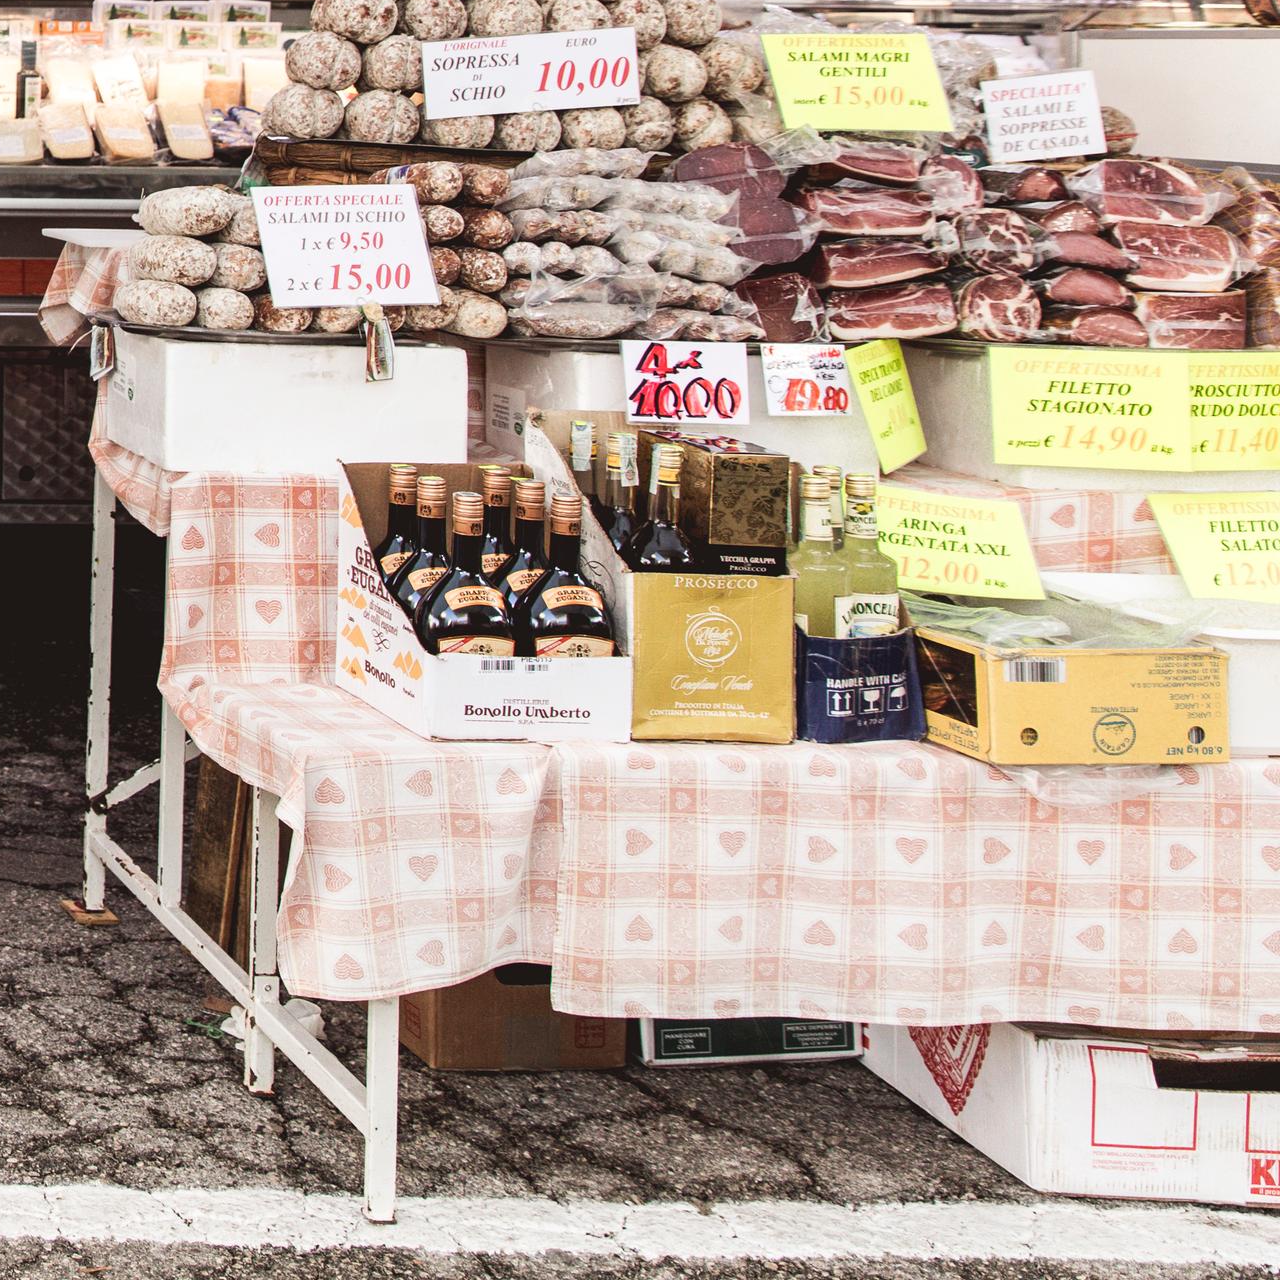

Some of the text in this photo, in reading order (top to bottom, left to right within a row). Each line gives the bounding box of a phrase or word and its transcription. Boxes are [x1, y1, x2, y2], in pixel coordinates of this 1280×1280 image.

[443, 39, 508, 53] L'ORIGINALE
[565, 37, 598, 48] EURO
[782, 36, 907, 48] OFFERTISSIMA
[787, 51, 910, 63] SALAMI MAGRI
[431, 53, 632, 97] SOPRESSA 10,00
[819, 66, 889, 78] GENTILI
[449, 86, 507, 103] SCHIO
[832, 86, 905, 108] 15,00
[990, 82, 1087, 103] SPECIALITA'
[1002, 103, 1063, 118] SALAMI
[999, 117, 1088, 136] SOPPRESSE
[1002, 135, 1091, 153] DE CASADA
[264, 194, 404, 207] OFFERTA SPECIALE
[268, 211, 406, 225] SALAMI DI SCHIO
[339, 231, 384, 253] 9,50
[329, 263, 411, 295] 15,00
[1014, 358, 1162, 379] OFFERTISSIMA
[1048, 380, 1132, 396] FILETTO
[1026, 399, 1153, 417] STAGIONATO
[1043, 424, 1148, 454] € 14,90
[1214, 427, 1279, 455] 11,40
[897, 518, 967, 536] ARINGA
[1210, 521, 1279, 533] FILETTO
[973, 542, 1012, 557] XXL
[899, 556, 980, 585] 12,00
[674, 575, 759, 590] PROSECCO
[364, 660, 396, 688] Bonollo
[827, 675, 890, 688] HANDLE WITH
[464, 705, 591, 719] Bonollo Umberto
[1166, 747, 1184, 756] NET
